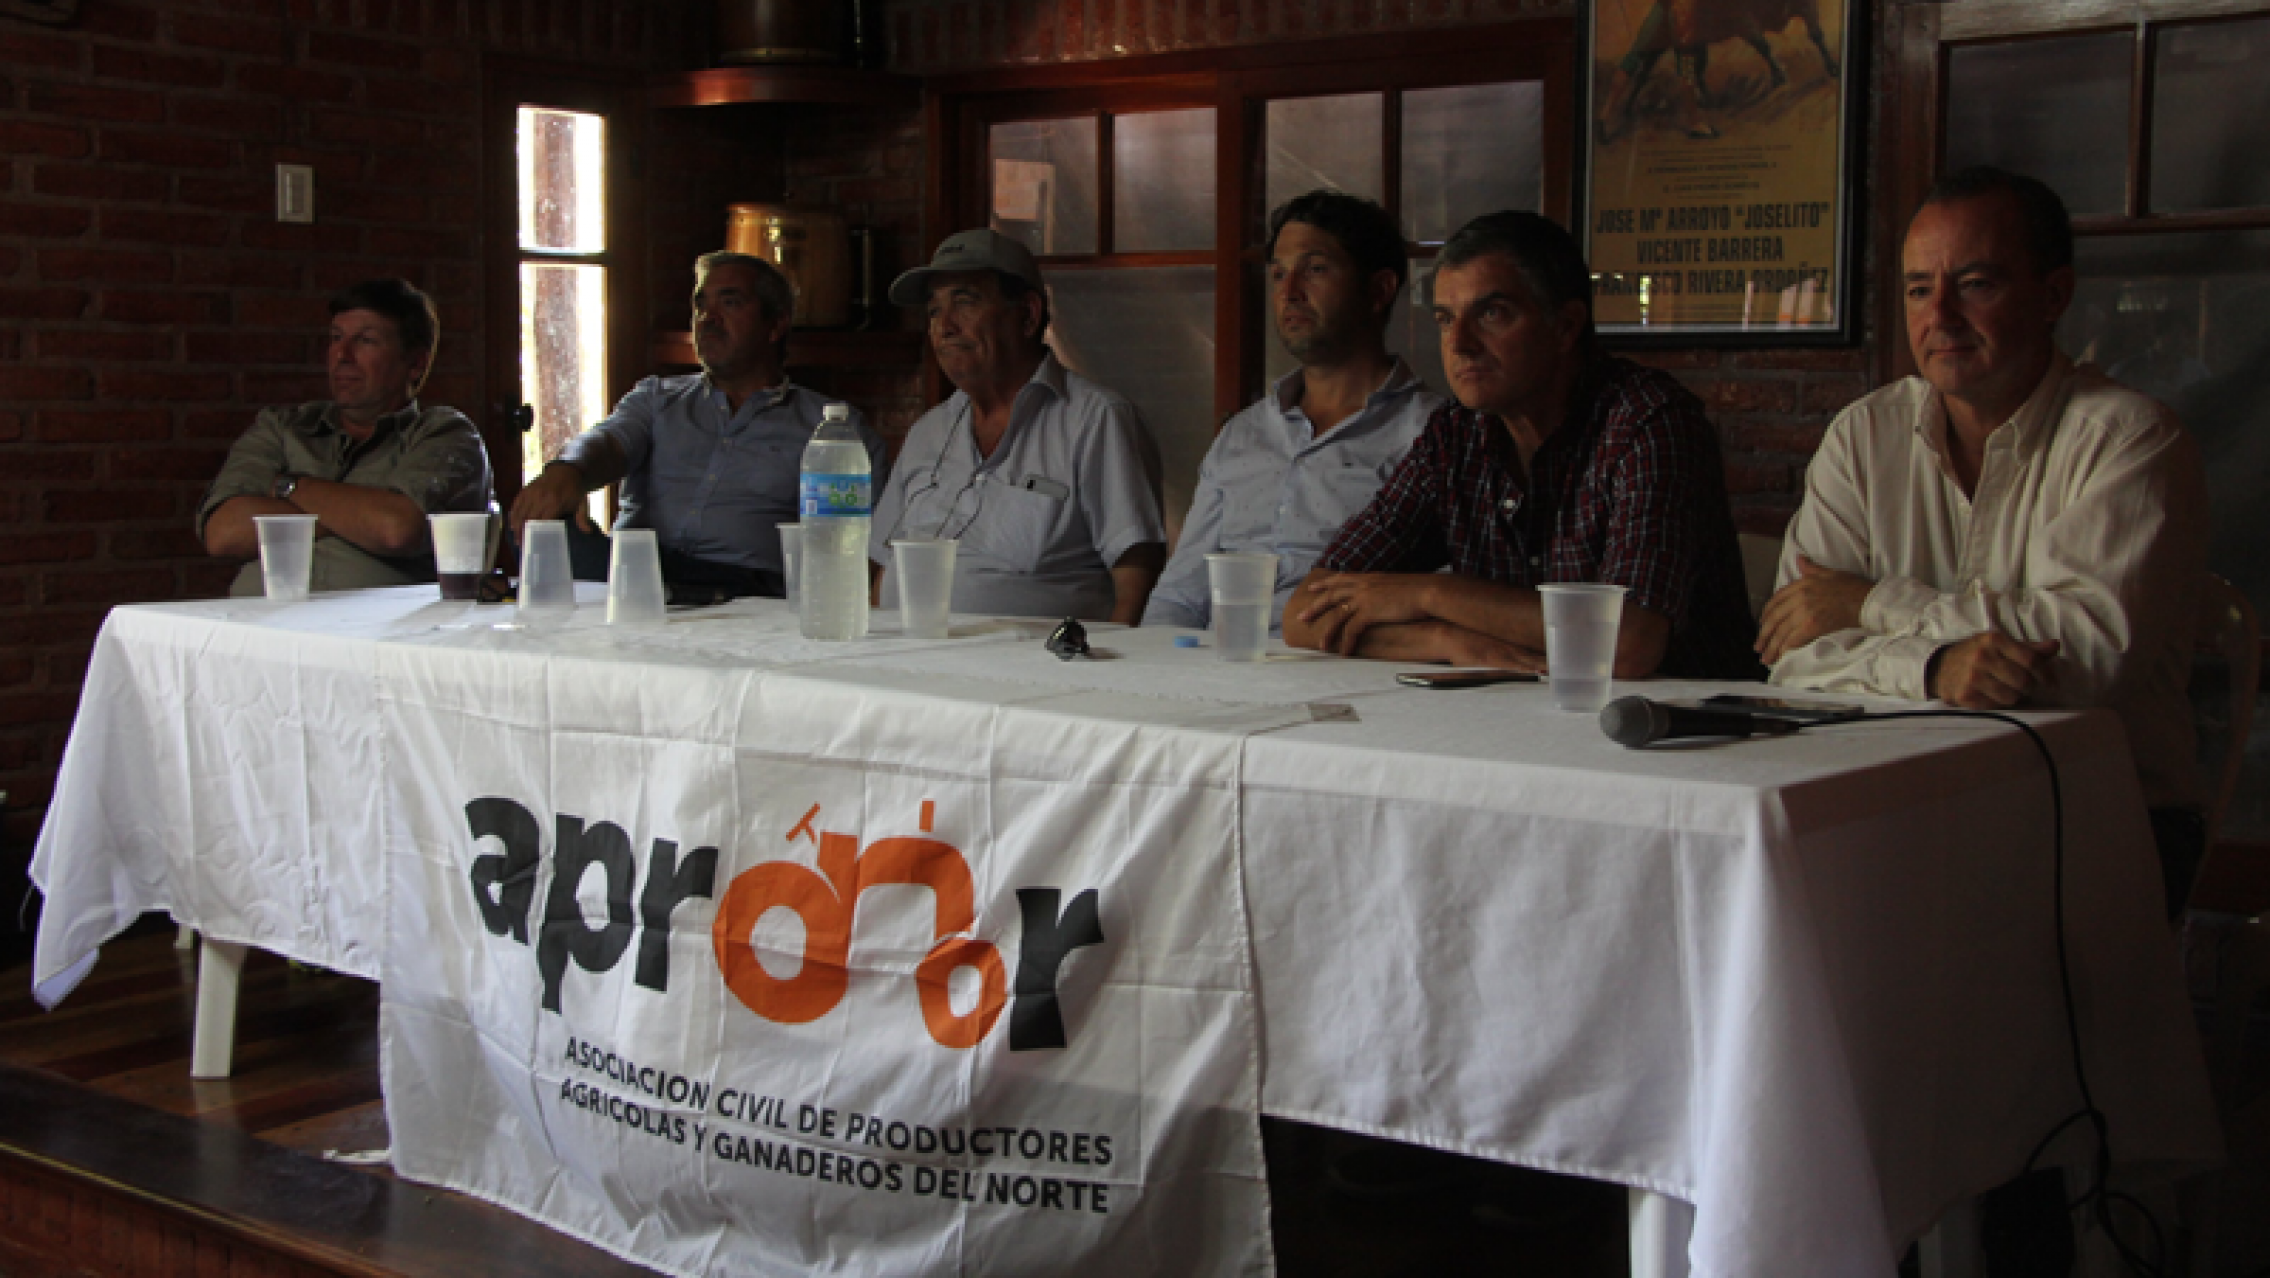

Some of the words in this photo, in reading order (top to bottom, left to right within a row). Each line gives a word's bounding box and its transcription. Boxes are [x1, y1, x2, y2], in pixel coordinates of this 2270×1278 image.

[1596, 208, 1635, 233] JOSE
[1665, 205, 1732, 231] ARROYO
[1734, 201, 1830, 229] "JOSELITO"
[1637, 237, 1702, 264] VICENTE
[1707, 236, 1785, 263] BARRERA
[1592, 269, 1682, 296] FRANSCO
[1687, 268, 1747, 294] RIVERA
[564, 1036, 710, 1112] ASOCIACION
[716, 1088, 787, 1129] CIVIL
[797, 1103, 837, 1138] DE
[845, 1111, 1112, 1166] PRODUCTORES
[560, 1078, 685, 1145] AGRICOLAS
[694, 1122, 707, 1152] Y
[714, 1132, 903, 1192] GANADEROS
[913, 1165, 976, 1201] DEL
[984, 1172, 1110, 1214] NORTE
